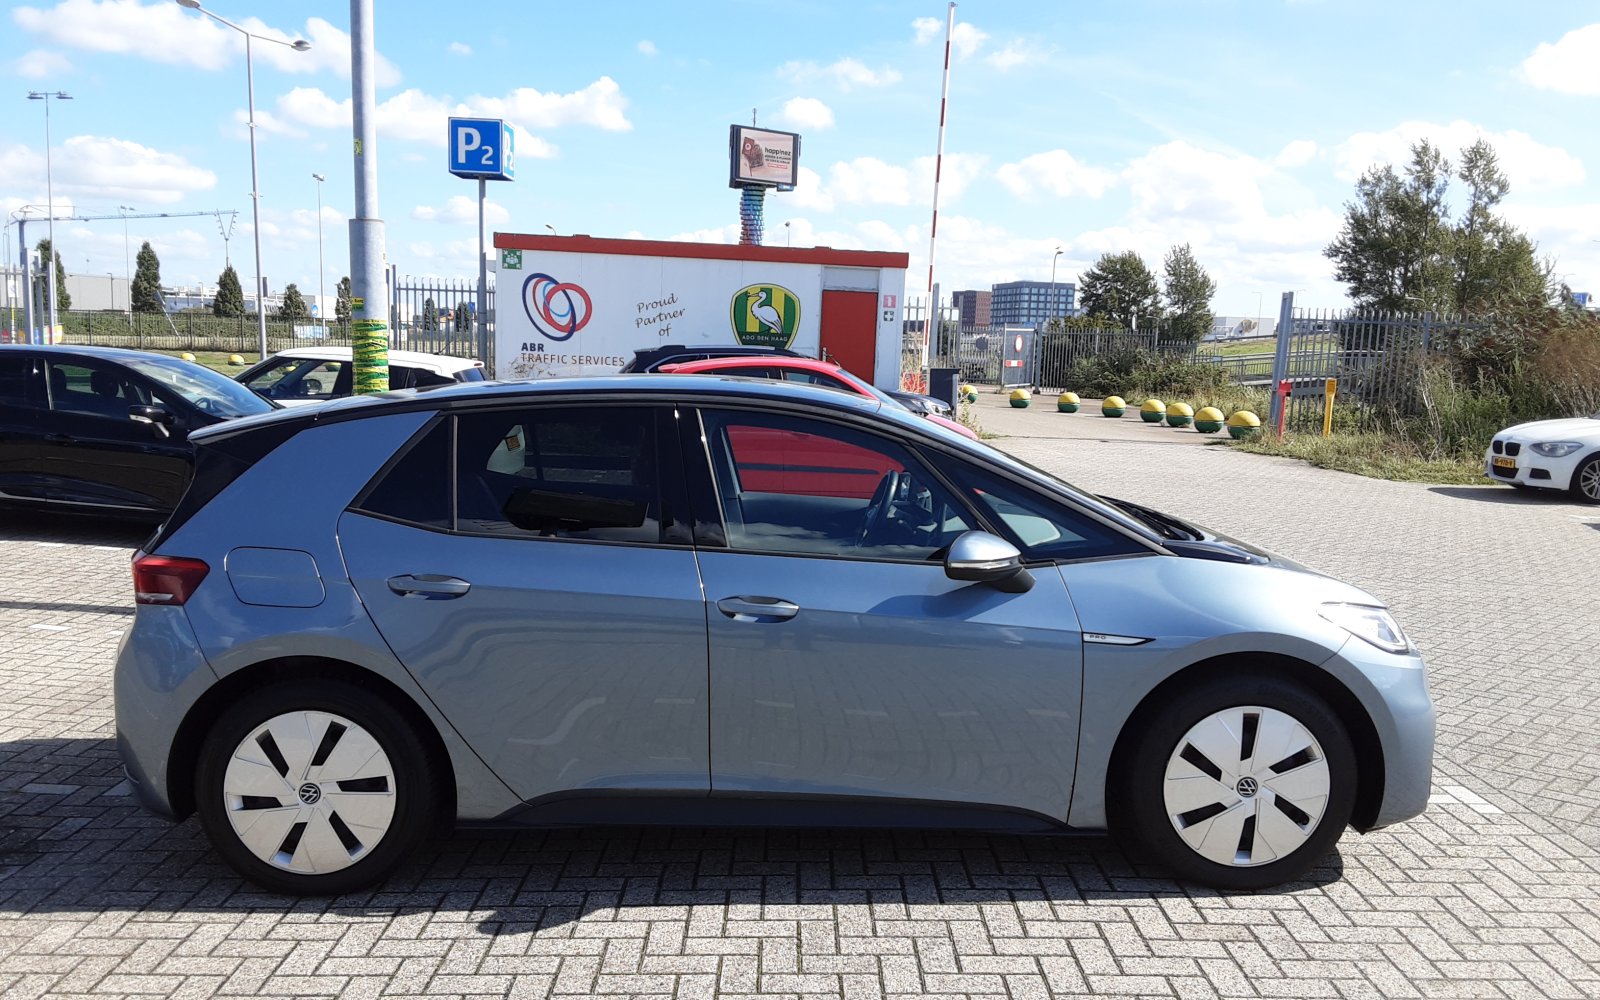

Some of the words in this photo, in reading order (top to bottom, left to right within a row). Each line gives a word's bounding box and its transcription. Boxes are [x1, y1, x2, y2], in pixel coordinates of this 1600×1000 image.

[457, 126, 494, 165] P2
[636, 292, 679, 313] Proud
[634, 308, 686, 329] Partner
[658, 322, 672, 337] of
[521, 342, 545, 352] ABR
[521, 352, 567, 364] TRAFFIC
[571, 355, 625, 367] SERVICES
